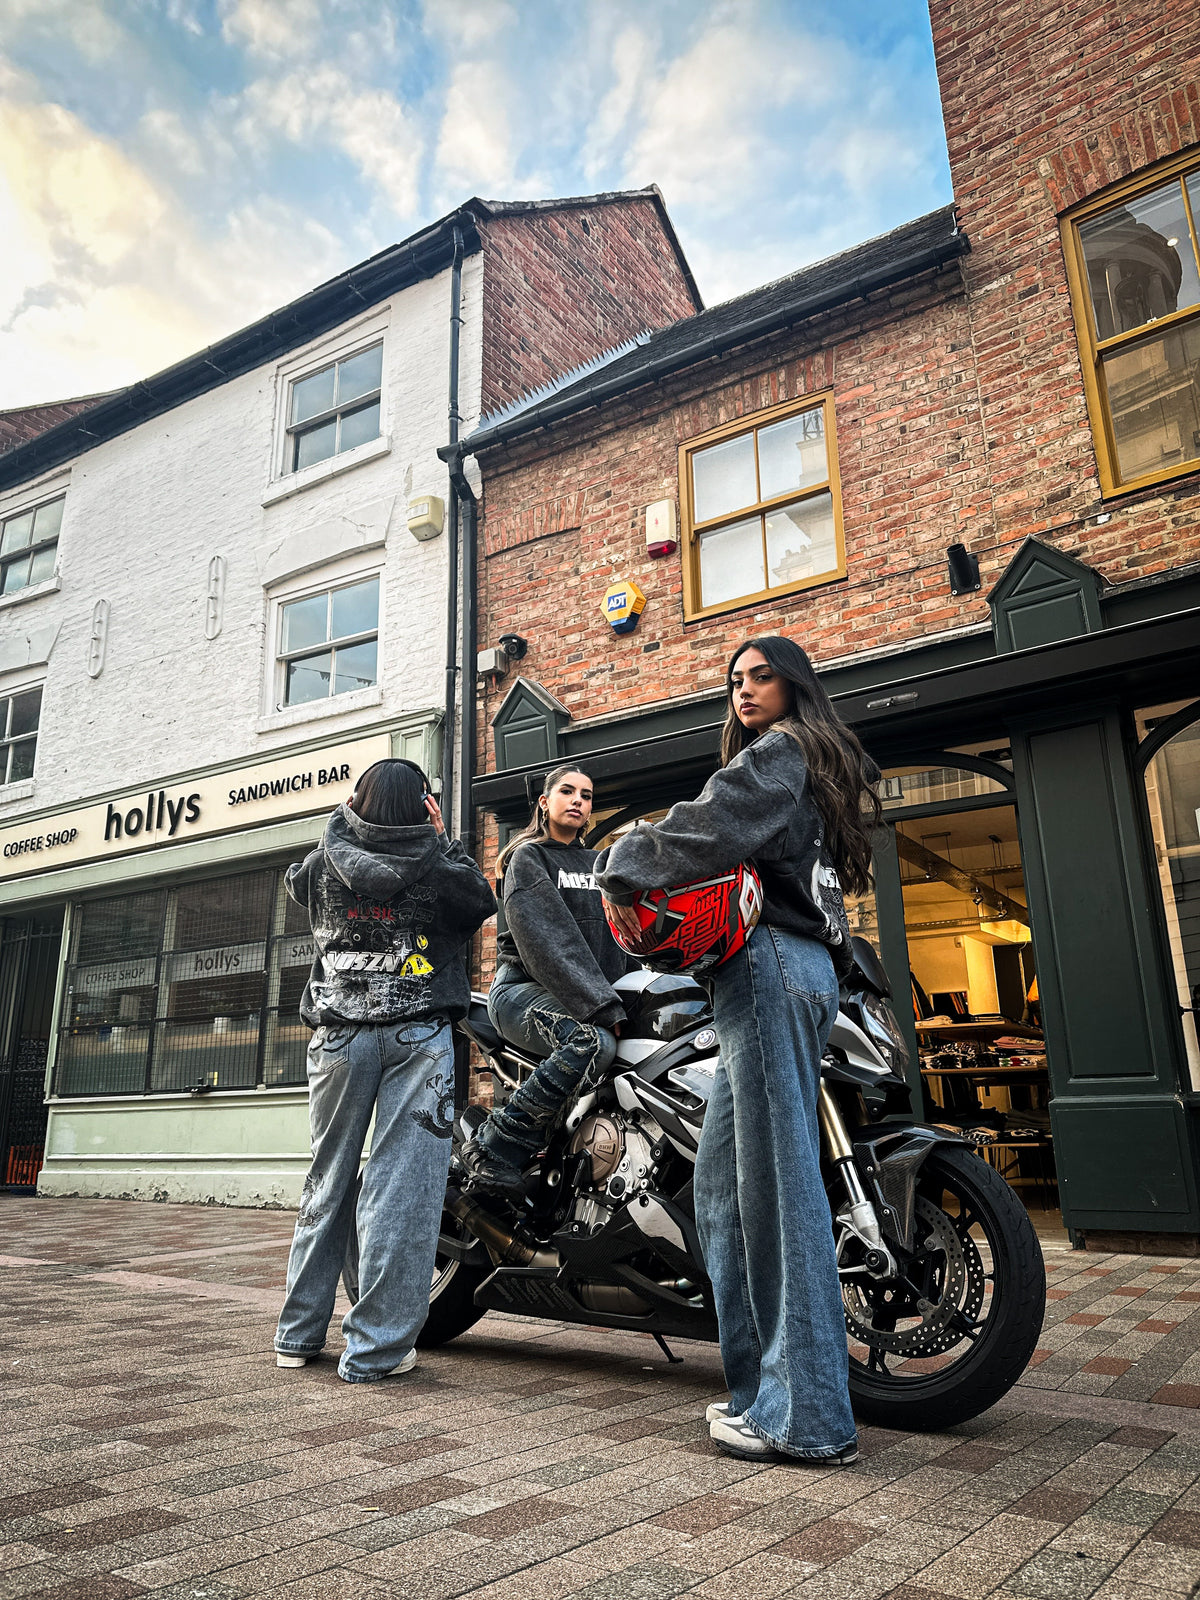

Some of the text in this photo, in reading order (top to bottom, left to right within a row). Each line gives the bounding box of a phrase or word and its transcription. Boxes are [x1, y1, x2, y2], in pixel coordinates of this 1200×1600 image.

[608, 595, 626, 610] ADT
[228, 764, 350, 806] SANDWICH BAR
[104, 790, 201, 841] hollys
[3, 828, 77, 858] COFFEE SHOP
[558, 868, 600, 891] NOSZ
[347, 906, 397, 921] MUSIC
[194, 950, 241, 973] hollys
[86, 967, 144, 985] COFFEE SHOP
